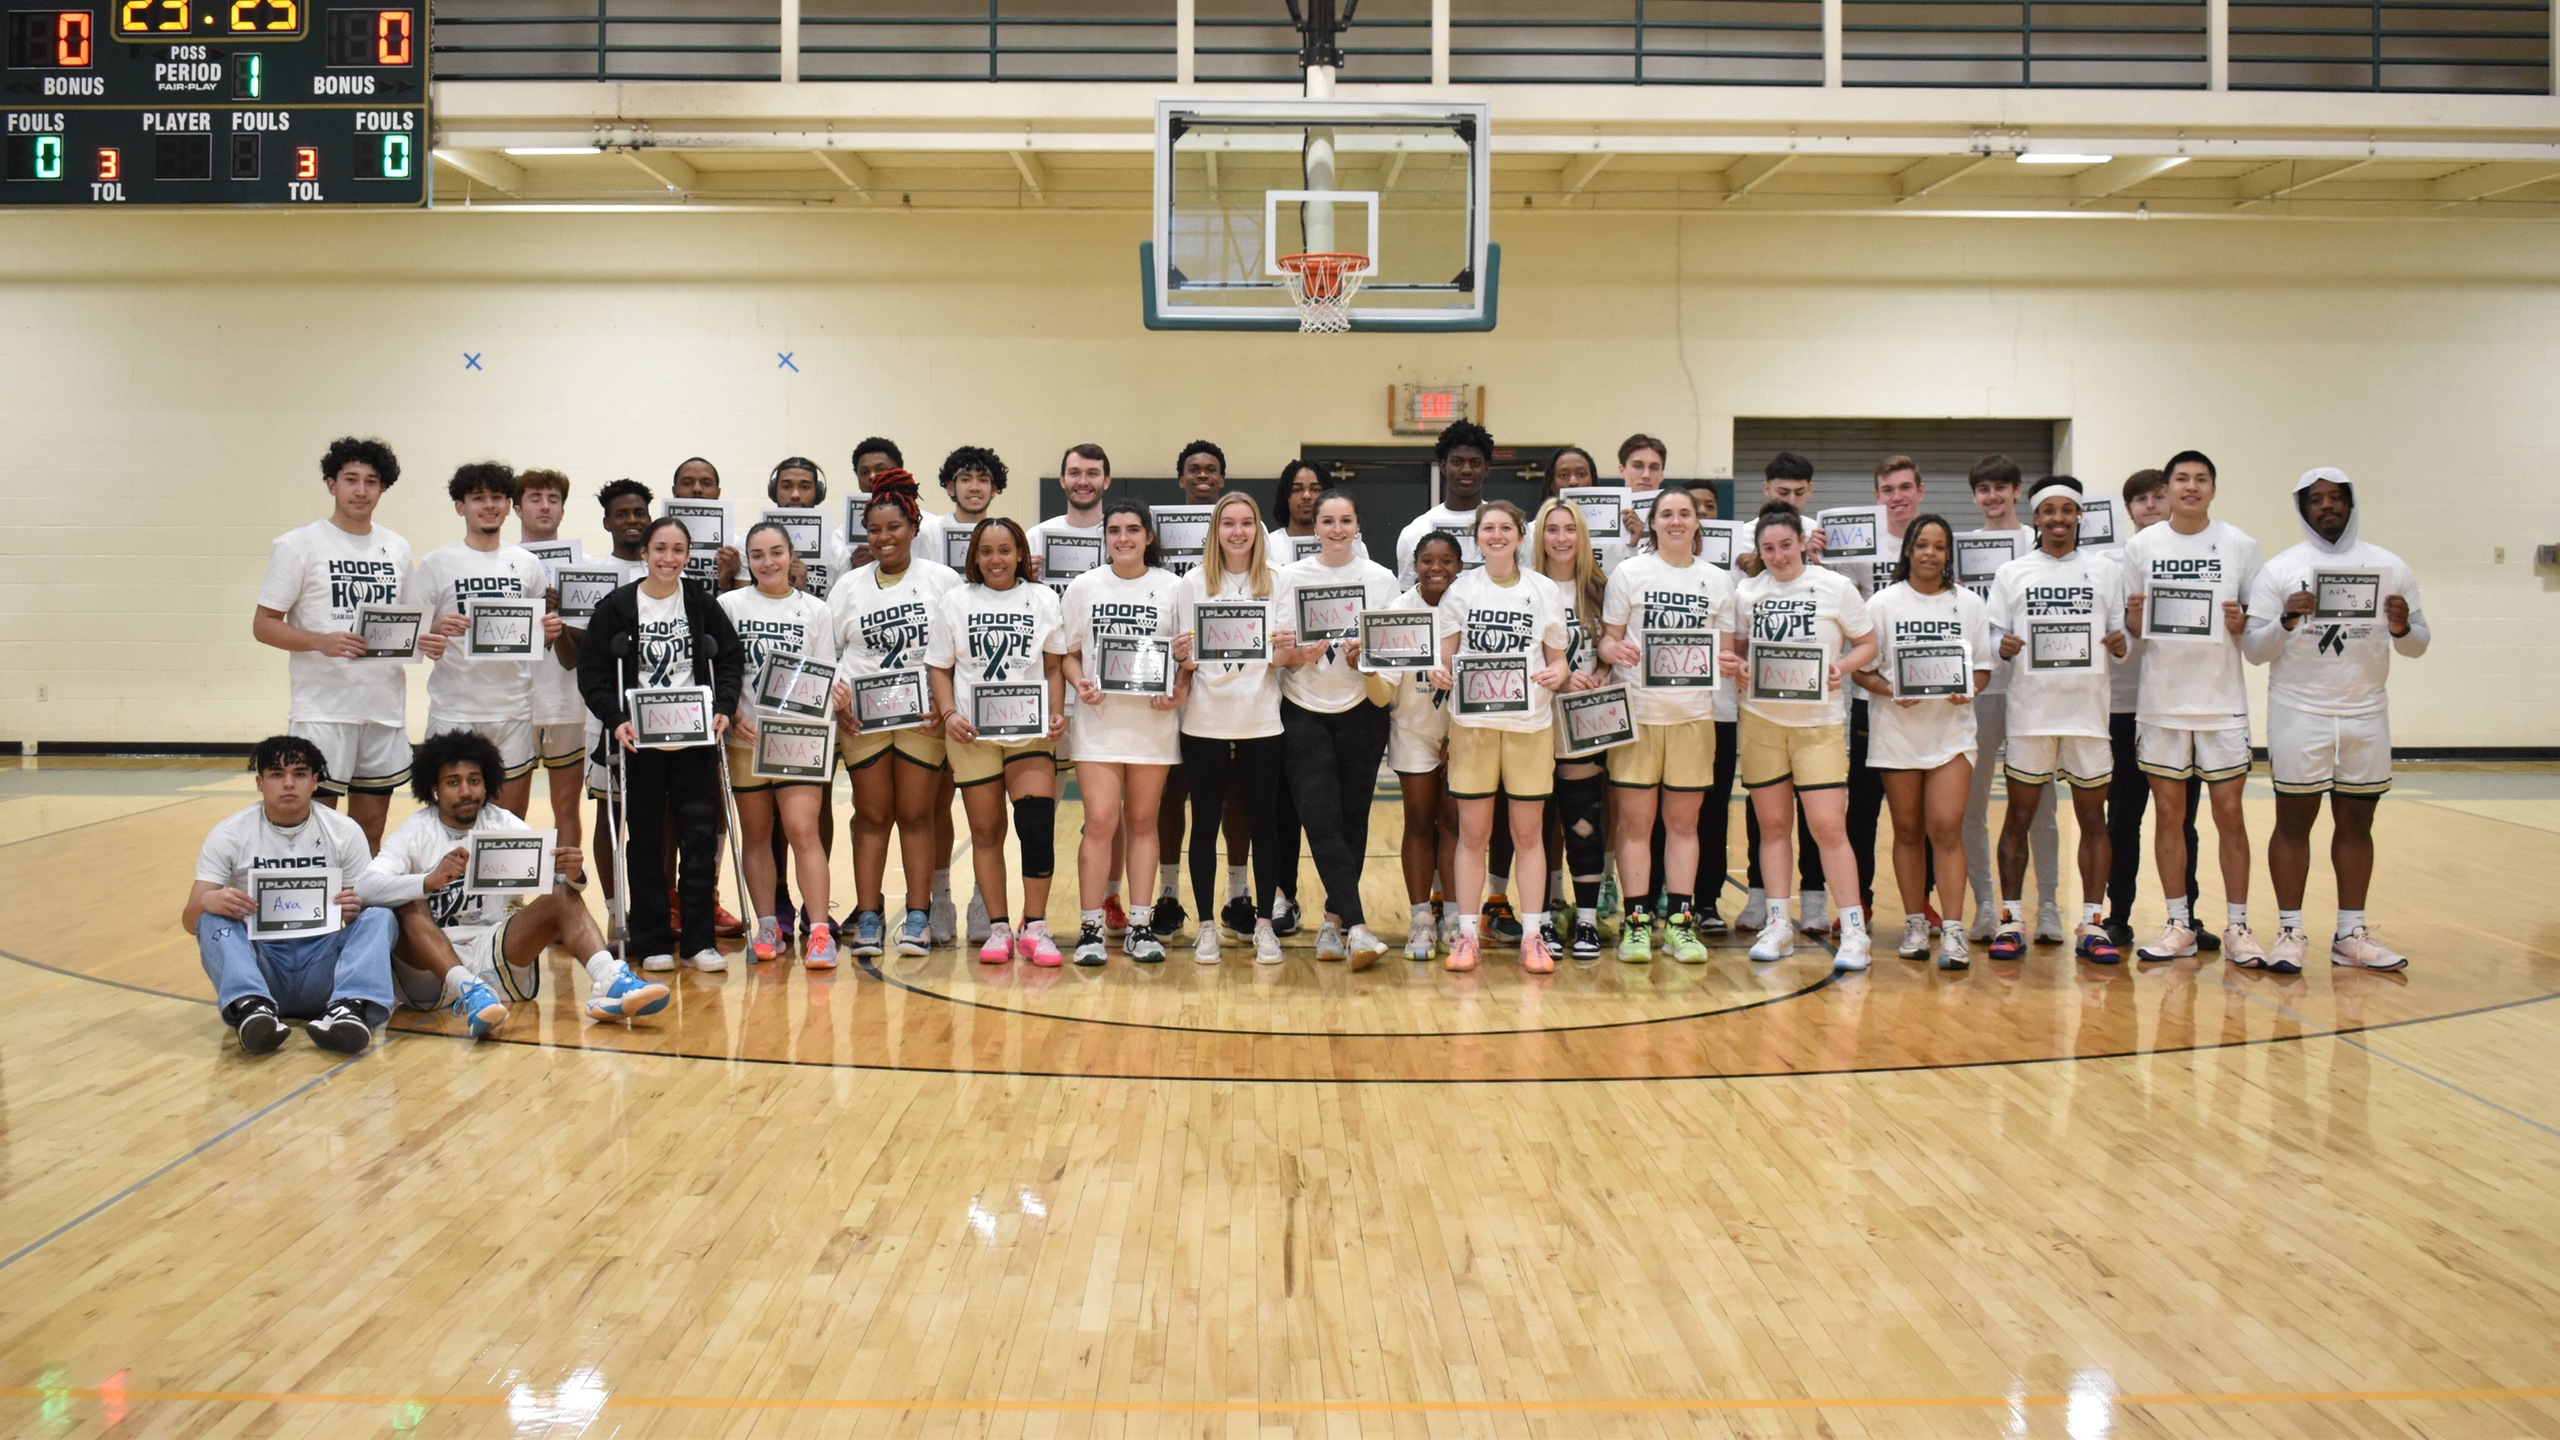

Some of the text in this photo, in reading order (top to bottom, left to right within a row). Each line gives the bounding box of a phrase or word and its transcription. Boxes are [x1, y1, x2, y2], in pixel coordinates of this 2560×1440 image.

[59, 12, 90, 65] 0
[379, 11, 410, 65] 0
[171, 46, 206, 59] POSS
[155, 63, 222, 81] PERIOD
[250, 55, 259, 98] 1
[44, 77, 104, 96] BONUS
[314, 76, 375, 94] BONUS
[8, 113, 65, 131] FOULS
[143, 113, 289, 130] PLAYER FOULS
[356, 112, 414, 130] FOULS
[36, 136, 61, 178] 0
[299, 149, 315, 178] 3
[384, 134, 409, 177] 0
[100, 150, 116, 178] 3
[91, 183, 125, 201] TOL
[289, 182, 323, 200] TOL
[1422, 393, 1451, 418] EXIT
[1829, 528, 1865, 546] AVA
[329, 560, 395, 575] HOOPS
[2152, 560, 2221, 572] HOOPS
[455, 578, 522, 592] HOOPS
[1306, 591, 1338, 599] PLAY
[1340, 589, 1364, 597] FOR
[1644, 592, 1709, 608] HOOPS
[2026, 588, 2093, 600] HOOPS
[861, 602, 926, 628] HOOPS
[1092, 604, 1157, 619] HOOPS
[1309, 607, 1342, 628] AVA
[1468, 609, 1533, 628] HOOPS
[968, 613, 1034, 627] HOOPS
[1407, 616, 1431, 624] FOR
[1896, 621, 1961, 635] HOOPS
[369, 628, 393, 641] AVA
[483, 621, 517, 640] AVA
[739, 620, 804, 637] HOOPS
[2043, 637, 2073, 652] AVA
[1797, 651, 1821, 659] FOR
[1905, 649, 1937, 657] PLAY
[810, 665, 834, 677] FOR
[1466, 661, 1499, 669] PLAY
[863, 678, 892, 689] PLAY
[982, 688, 1015, 696] PLAY
[1571, 696, 1601, 708] PLAY
[1602, 692, 1625, 701] FOR
[769, 725, 802, 734] PLAY
[804, 728, 827, 736] FOR
[1575, 715, 1610, 736] AVA
[768, 737, 807, 758] AVA
[254, 856, 326, 868] HOOPS
[482, 864, 509, 874] AVA
[273, 897, 302, 912] Ava
